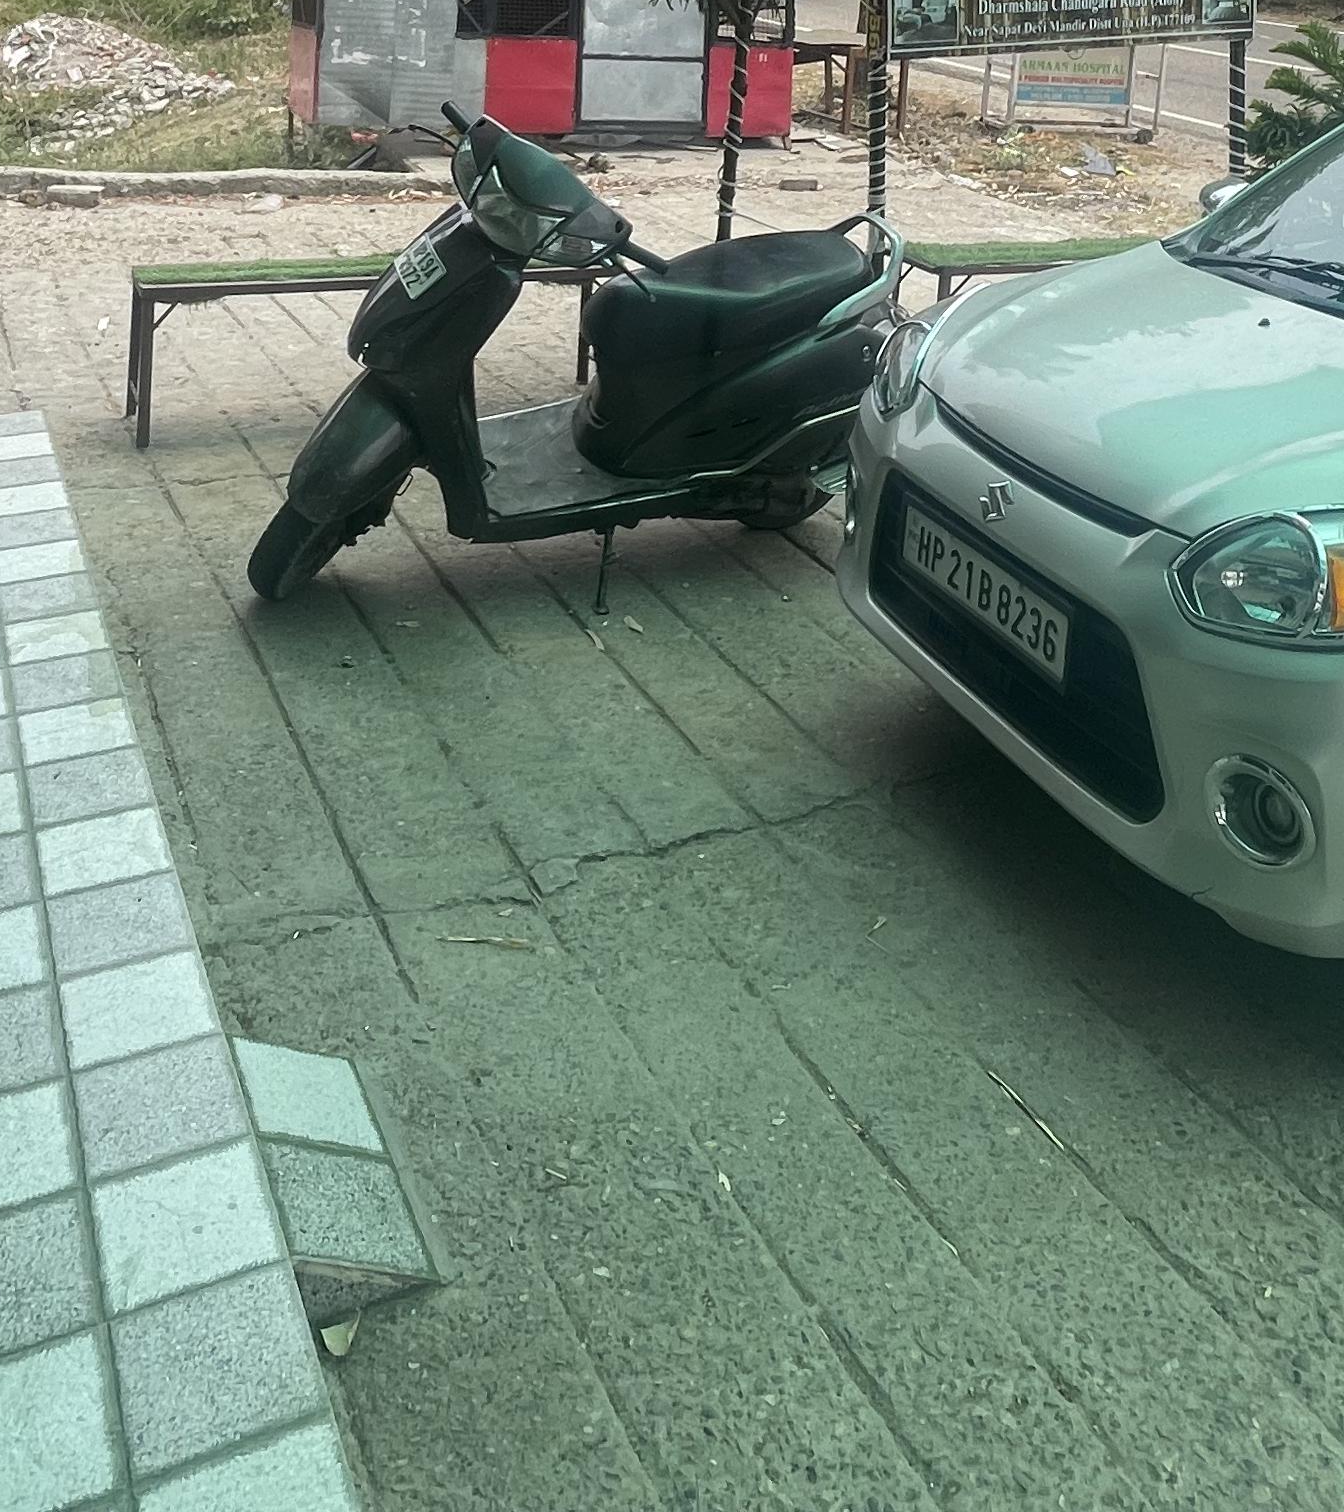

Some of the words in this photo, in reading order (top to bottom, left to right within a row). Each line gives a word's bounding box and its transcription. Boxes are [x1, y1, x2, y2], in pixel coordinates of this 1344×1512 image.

[964, 24, 990, 37] Near
[1050, 18, 1086, 33] Mandir
[1114, 16, 1134, 28] Una
[1074, 62, 1127, 76] HOSPITAL
[917, 526, 1057, 663] HP21B8236
